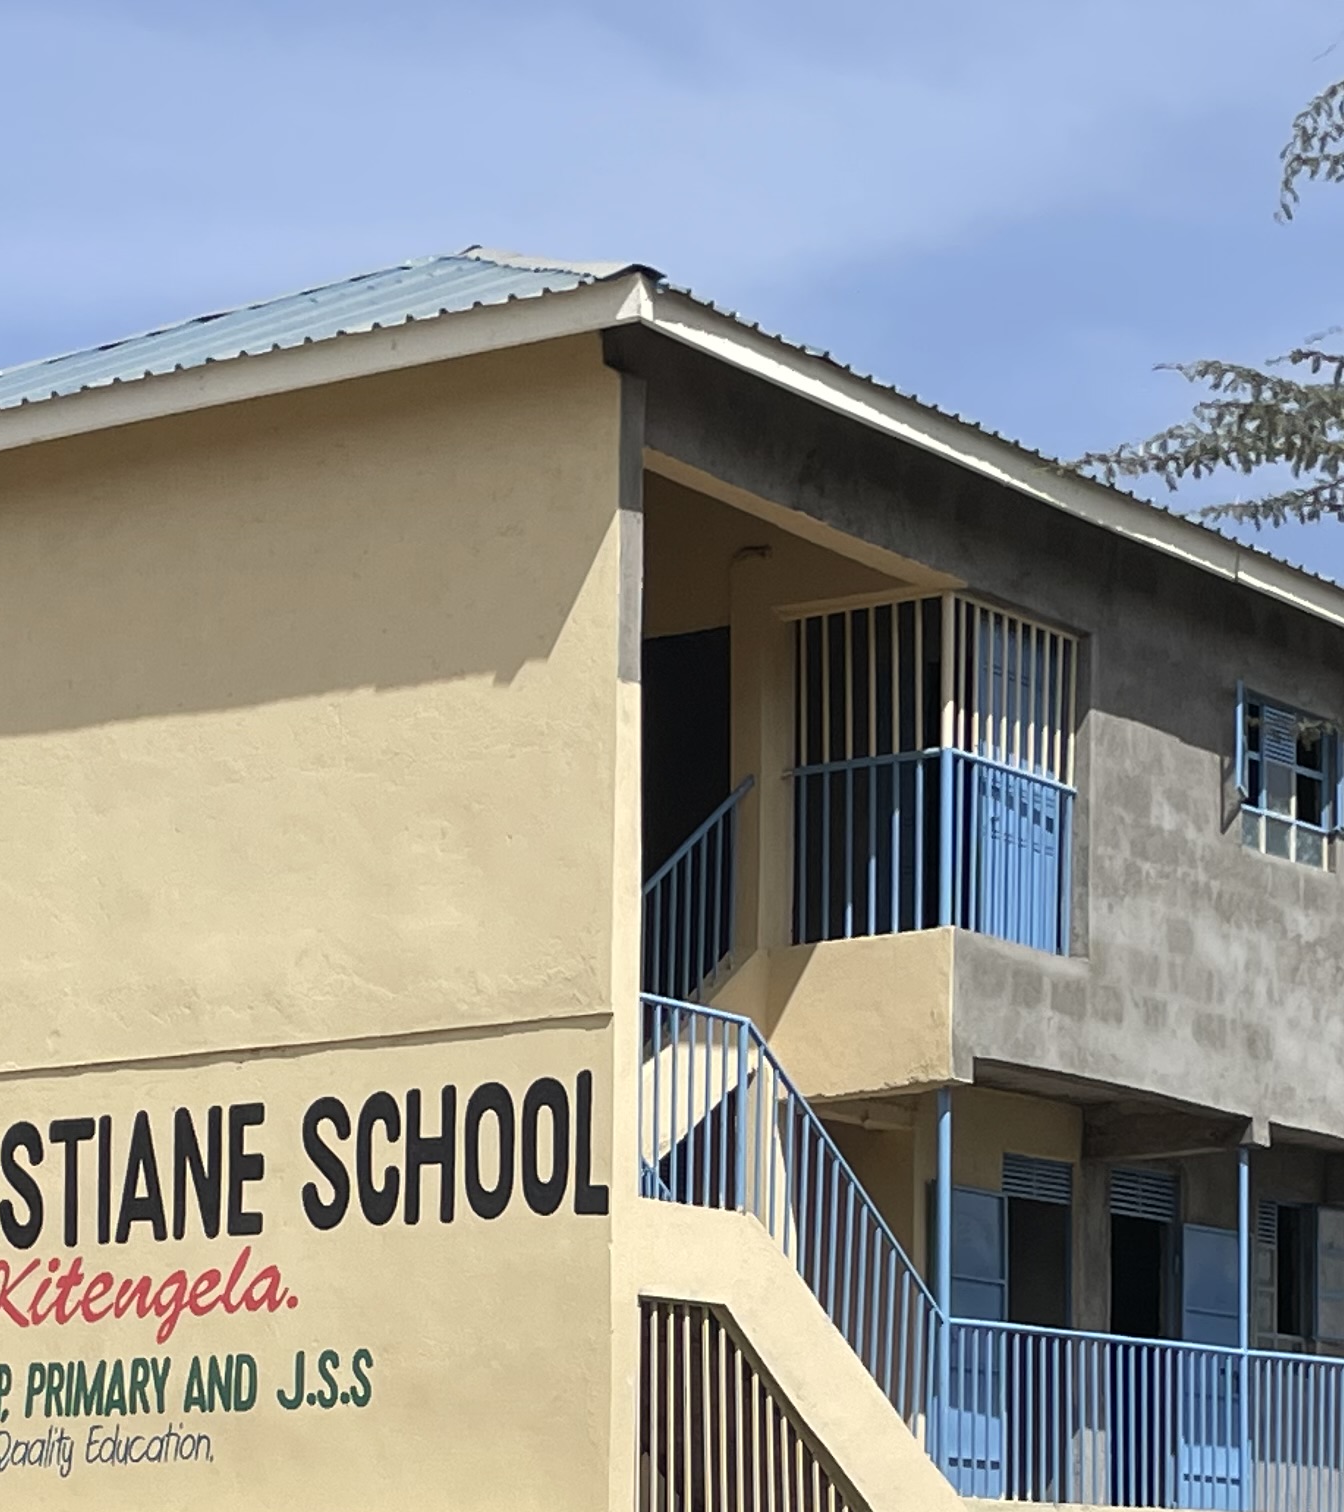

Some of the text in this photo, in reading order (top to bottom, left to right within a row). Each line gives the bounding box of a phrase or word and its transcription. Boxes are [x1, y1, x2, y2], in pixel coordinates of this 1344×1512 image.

[302, 1069, 609, 1230] SCHOOL
[25, 1356, 171, 1418] PRIMARY
[184, 1353, 257, 1413] AND
[276, 1348, 374, 1410] J.S.S
[86, 1422, 214, 1468] Education.
